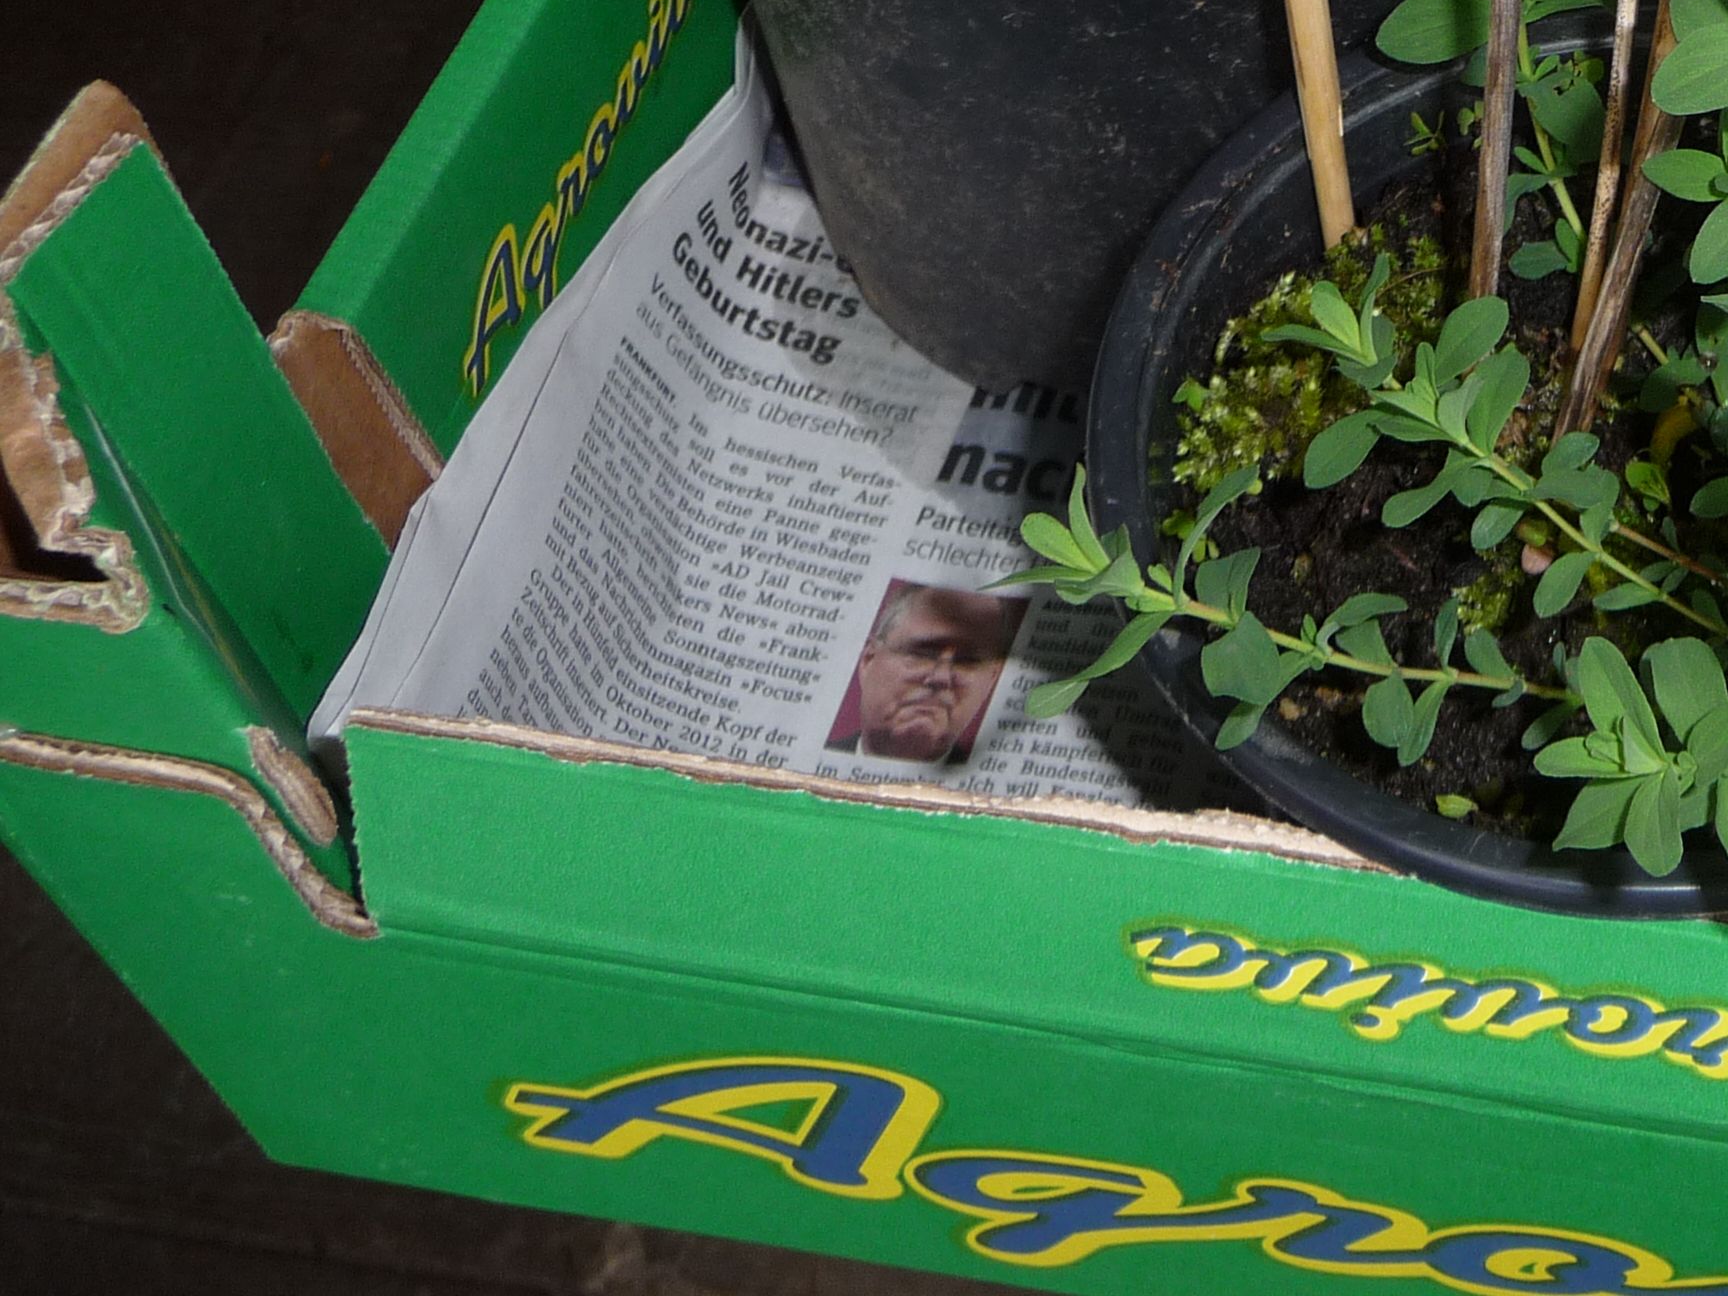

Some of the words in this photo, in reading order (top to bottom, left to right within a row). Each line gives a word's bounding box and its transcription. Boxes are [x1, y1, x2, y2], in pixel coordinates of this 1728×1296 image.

[697, 199, 732, 265] und
[736, 254, 860, 318] Hitlers
[672, 231, 843, 366] Geburtstag
[636, 304, 663, 339] aus
[757, 400, 893, 448] übersehen?
[839, 388, 918, 424] Inserat
[688, 440, 714, 464] soll
[728, 463, 749, 477] es
[765, 472, 795, 487] vor
[807, 479, 840, 497] der
[724, 437, 819, 473] hessischen
[936, 445, 1069, 504] nac
[660, 431, 679, 457] des
[686, 458, 774, 504] Netzwerks
[787, 494, 888, 528] inhaftierter
[678, 495, 745, 538] Behörde
[749, 524, 768, 543] in
[776, 531, 871, 566] Wiesbaden
[715, 500, 752, 519] eine
[762, 508, 821, 535] Panne
[828, 526, 878, 546] gege-
[740, 544, 863, 586] Werbeanzeige
[903, 539, 1021, 573] schlechter
[685, 572, 711, 593] sie
[718, 583, 748, 603] die
[755, 588, 845, 623] Motorrad-
[754, 567, 790, 590] Jail
[716, 624, 746, 646] die
[606, 685, 675, 733] Oktober
[678, 725, 723, 754] 2012
[728, 742, 748, 762] in
[755, 749, 789, 770] der
[613, 716, 650, 744] Der
[714, 713, 763, 742] Kopf
[764, 728, 798, 748] der
[979, 757, 1007, 773] die
[1006, 781, 1039, 798] will
